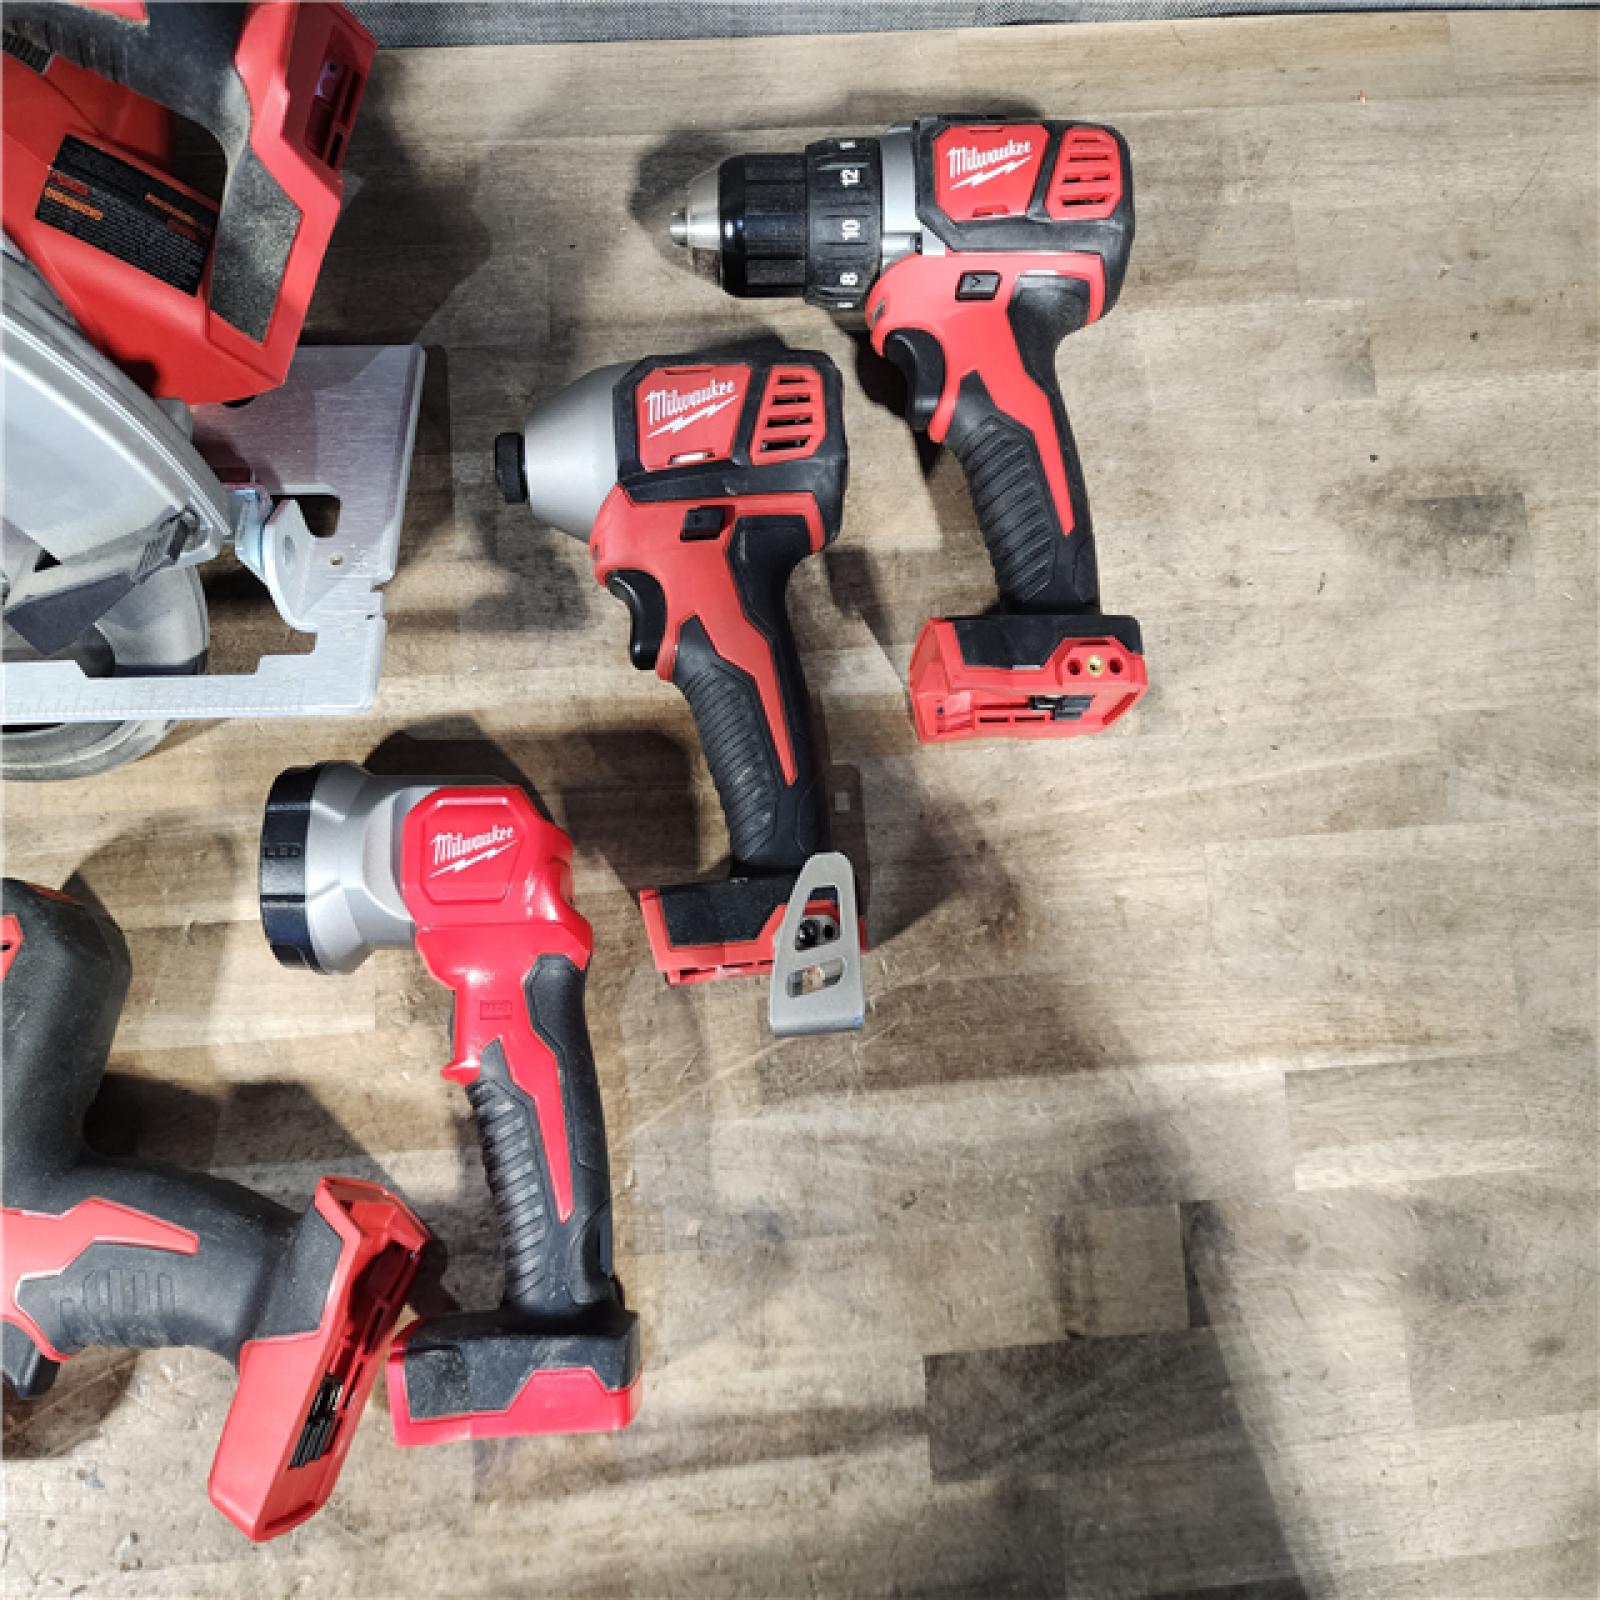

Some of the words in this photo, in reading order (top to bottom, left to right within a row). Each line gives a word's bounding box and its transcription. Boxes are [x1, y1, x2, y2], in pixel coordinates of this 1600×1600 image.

[840, 169, 860, 187] 12
[945, 138, 1031, 179] Milwaukee
[841, 219, 860, 240] 10
[643, 379, 736, 426] Milwaukee
[430, 824, 514, 866] Milwaukee
